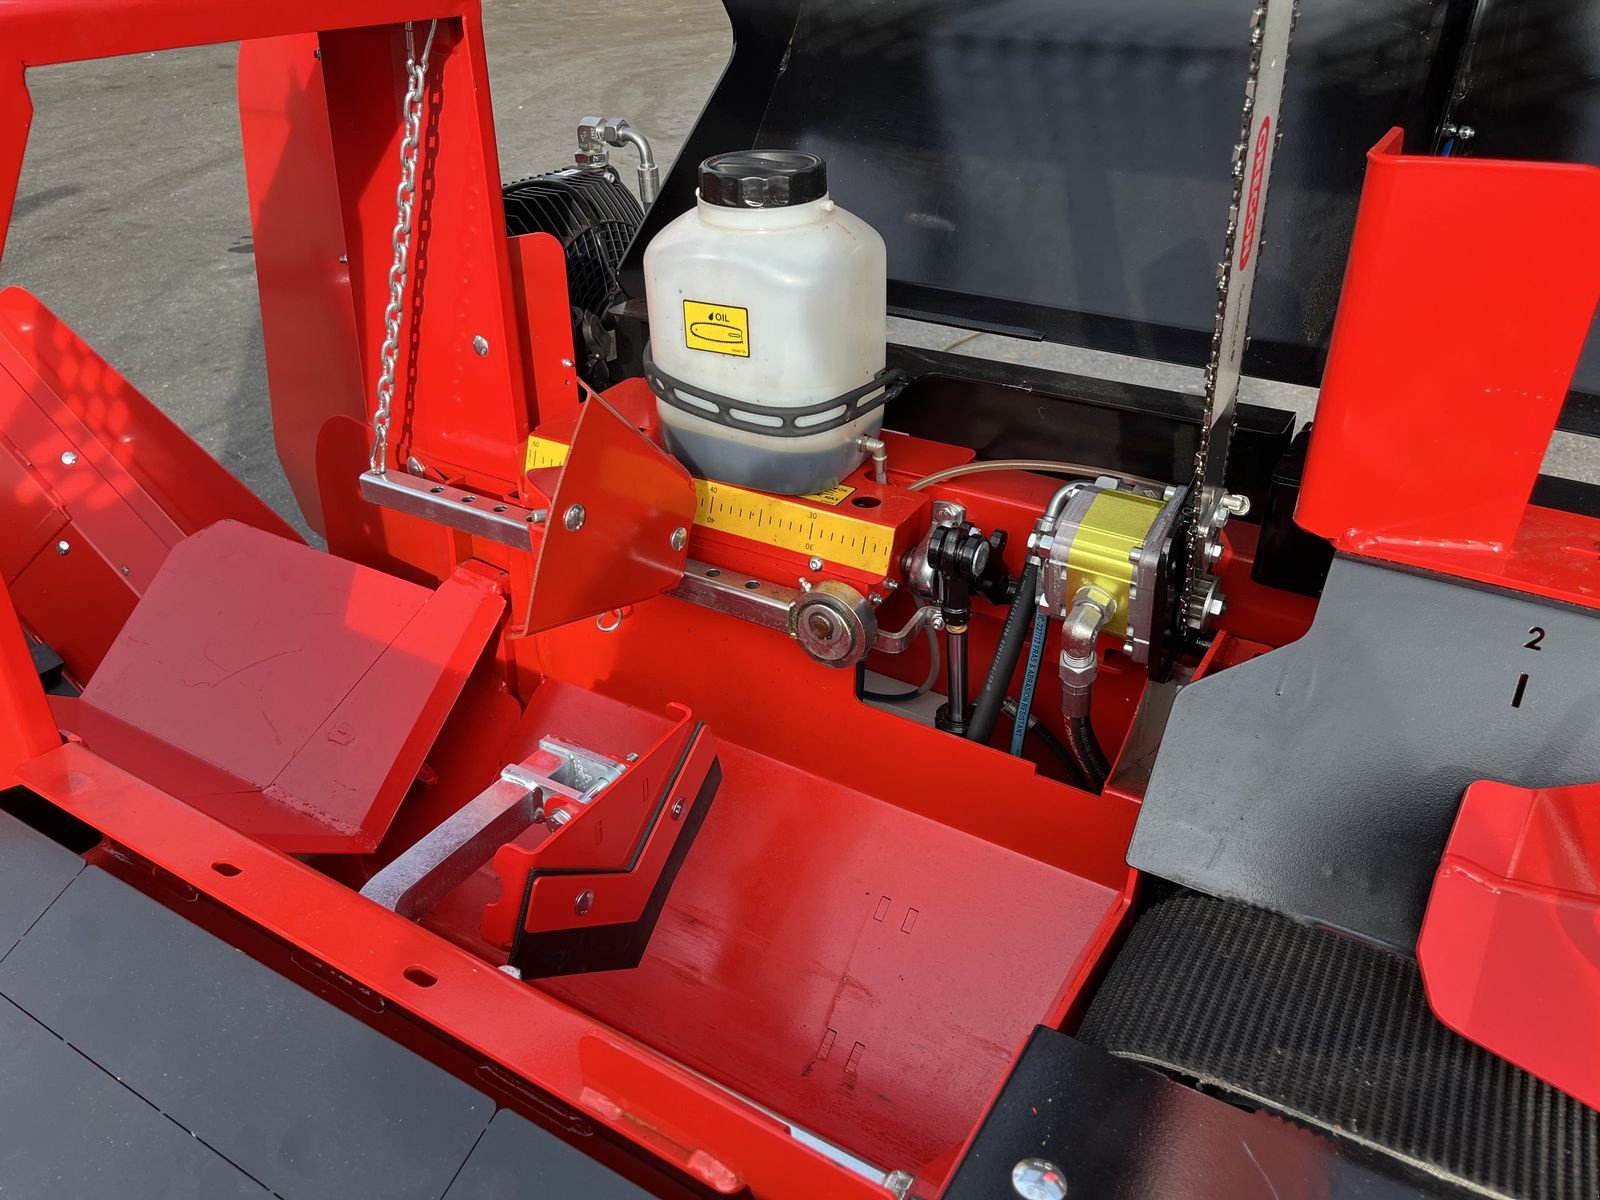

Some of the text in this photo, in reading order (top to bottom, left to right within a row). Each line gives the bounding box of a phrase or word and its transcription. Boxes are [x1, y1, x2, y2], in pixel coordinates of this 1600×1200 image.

[1243, 127, 1267, 258] OREGON
[715, 312, 730, 323] OIL
[709, 486, 718, 494] 40
[808, 511, 818, 520] 30
[1523, 626, 1545, 651] 2
[1030, 645, 1040, 663] FRAS
[1022, 669, 1035, 702] ABRASION
[1015, 702, 1028, 737] RESISTANT
